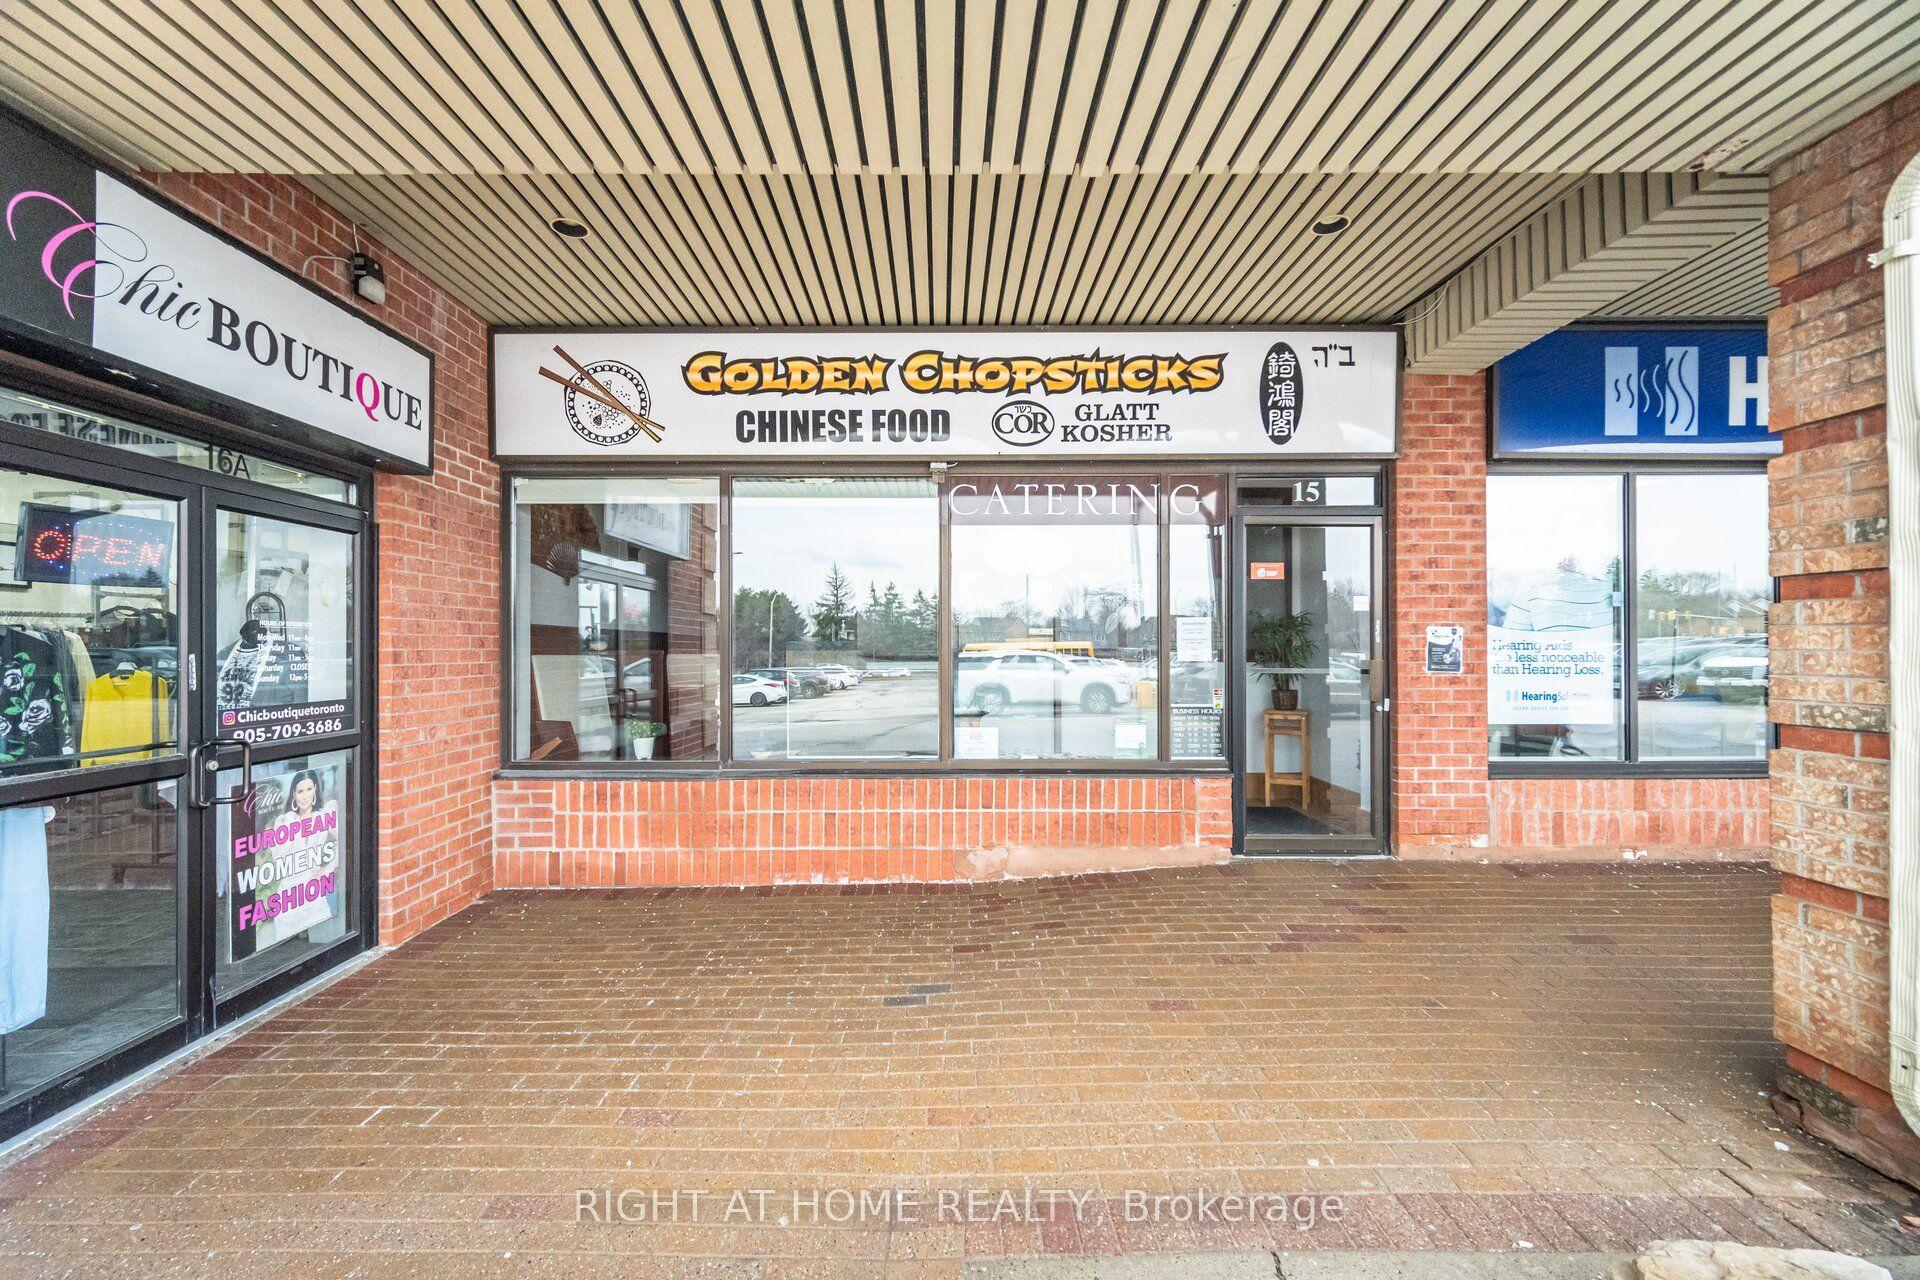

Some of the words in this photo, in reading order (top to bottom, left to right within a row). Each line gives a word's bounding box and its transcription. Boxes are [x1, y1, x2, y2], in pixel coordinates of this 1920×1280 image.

[6, 190, 202, 330] Chic
[207, 297, 422, 431] BOUTIQUE
[681, 350, 895, 396] GOLDEN
[898, 346, 1229, 396] CHOPSTICKS
[736, 409, 863, 443] CHINESE
[872, 409, 950, 443] FOOD
[995, 412, 1051, 434] COR
[1074, 403, 1159, 421] GLATT
[1060, 424, 1172, 442] KOSHER
[203, 444, 250, 479] 16A
[949, 483, 1202, 516] CATERING
[1292, 481, 1321, 502] 15
[34, 529, 164, 568] OPEN
[1492, 664, 1519, 675] than
[1522, 664, 1571, 677] Hearing
[1574, 664, 1604, 675] Loss.
[1515, 652, 1538, 662] less
[237, 704, 344, 722] Chicboutiquetoronto
[233, 718, 342, 742] 905-709-3686
[234, 811, 337, 859] EUROPEAN
[237, 840, 336, 895] WOMENS
[238, 872, 335, 931] FASHION
